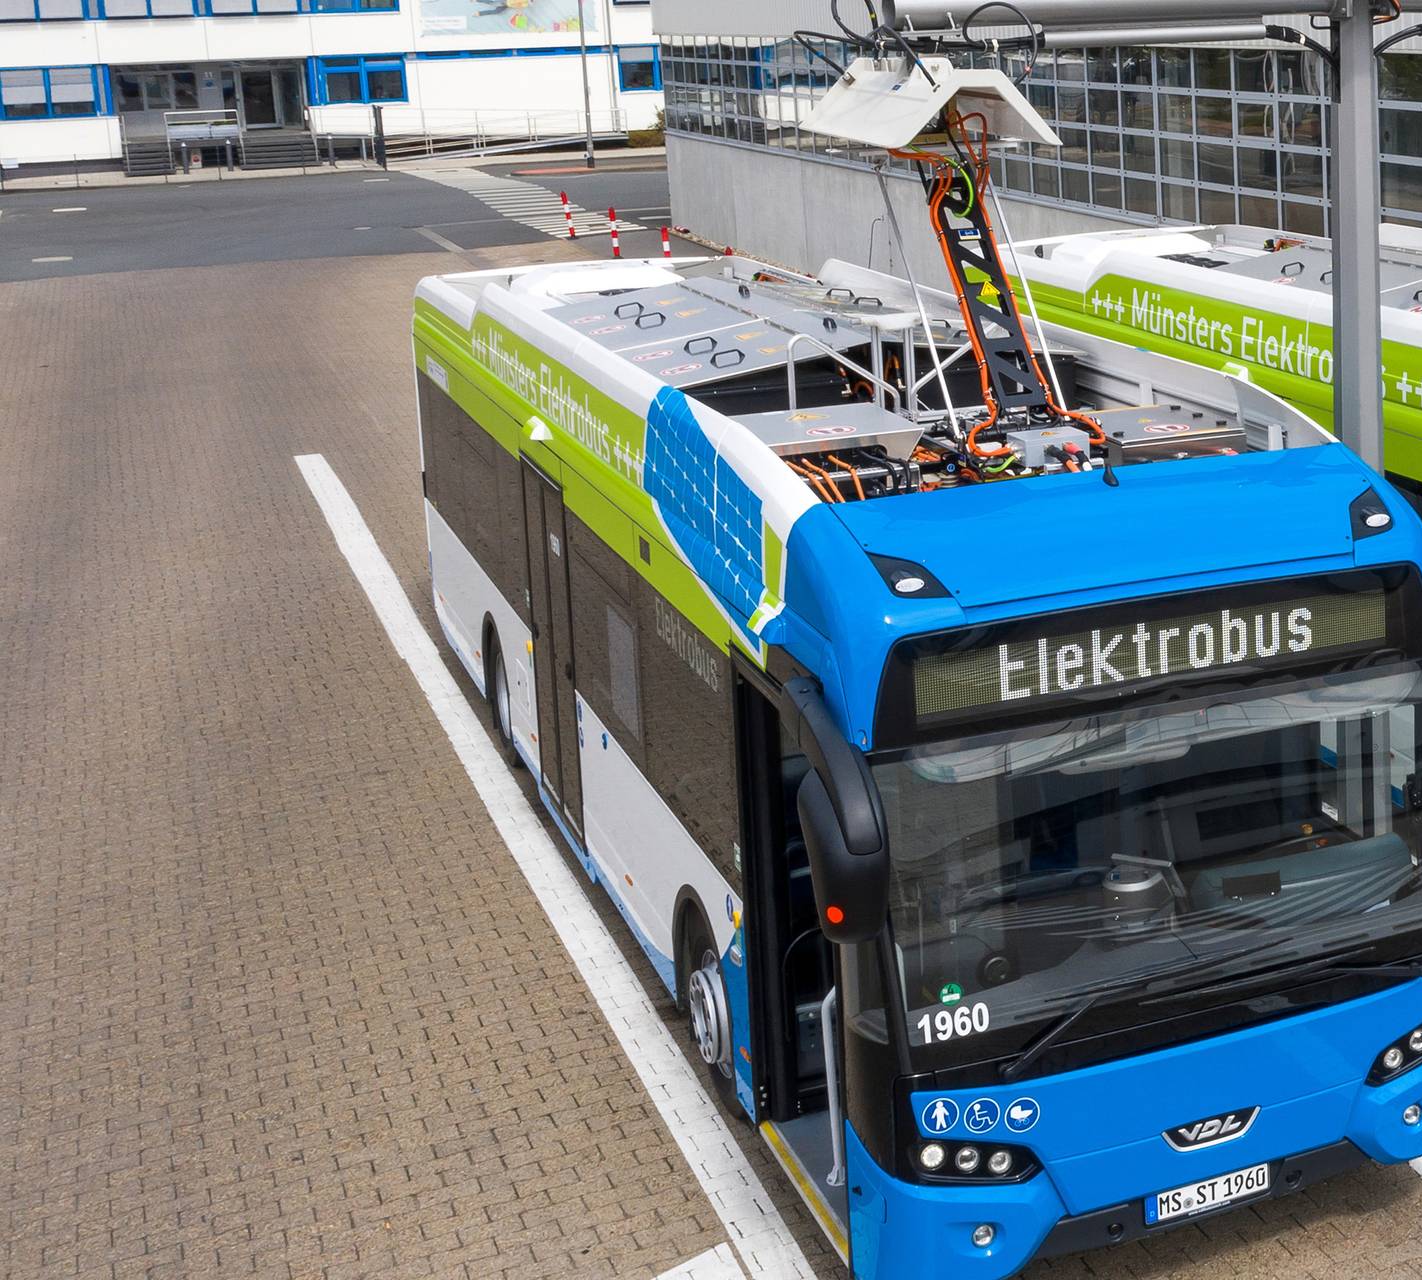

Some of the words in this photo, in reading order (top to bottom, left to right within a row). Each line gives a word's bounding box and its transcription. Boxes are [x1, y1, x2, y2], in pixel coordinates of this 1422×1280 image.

[1131, 287, 1233, 355] Münsters
[488, 327, 537, 406] Münsters
[540, 362, 612, 467] Elektrobus
[999, 606, 1313, 702] Elektrobus
[917, 1002, 990, 1044] 1960
[1178, 1114, 1242, 1141] VDL
[1158, 1191, 1182, 1216] MS
[1196, 1181, 1218, 1205] ST
[1223, 1167, 1266, 1198] 1960
